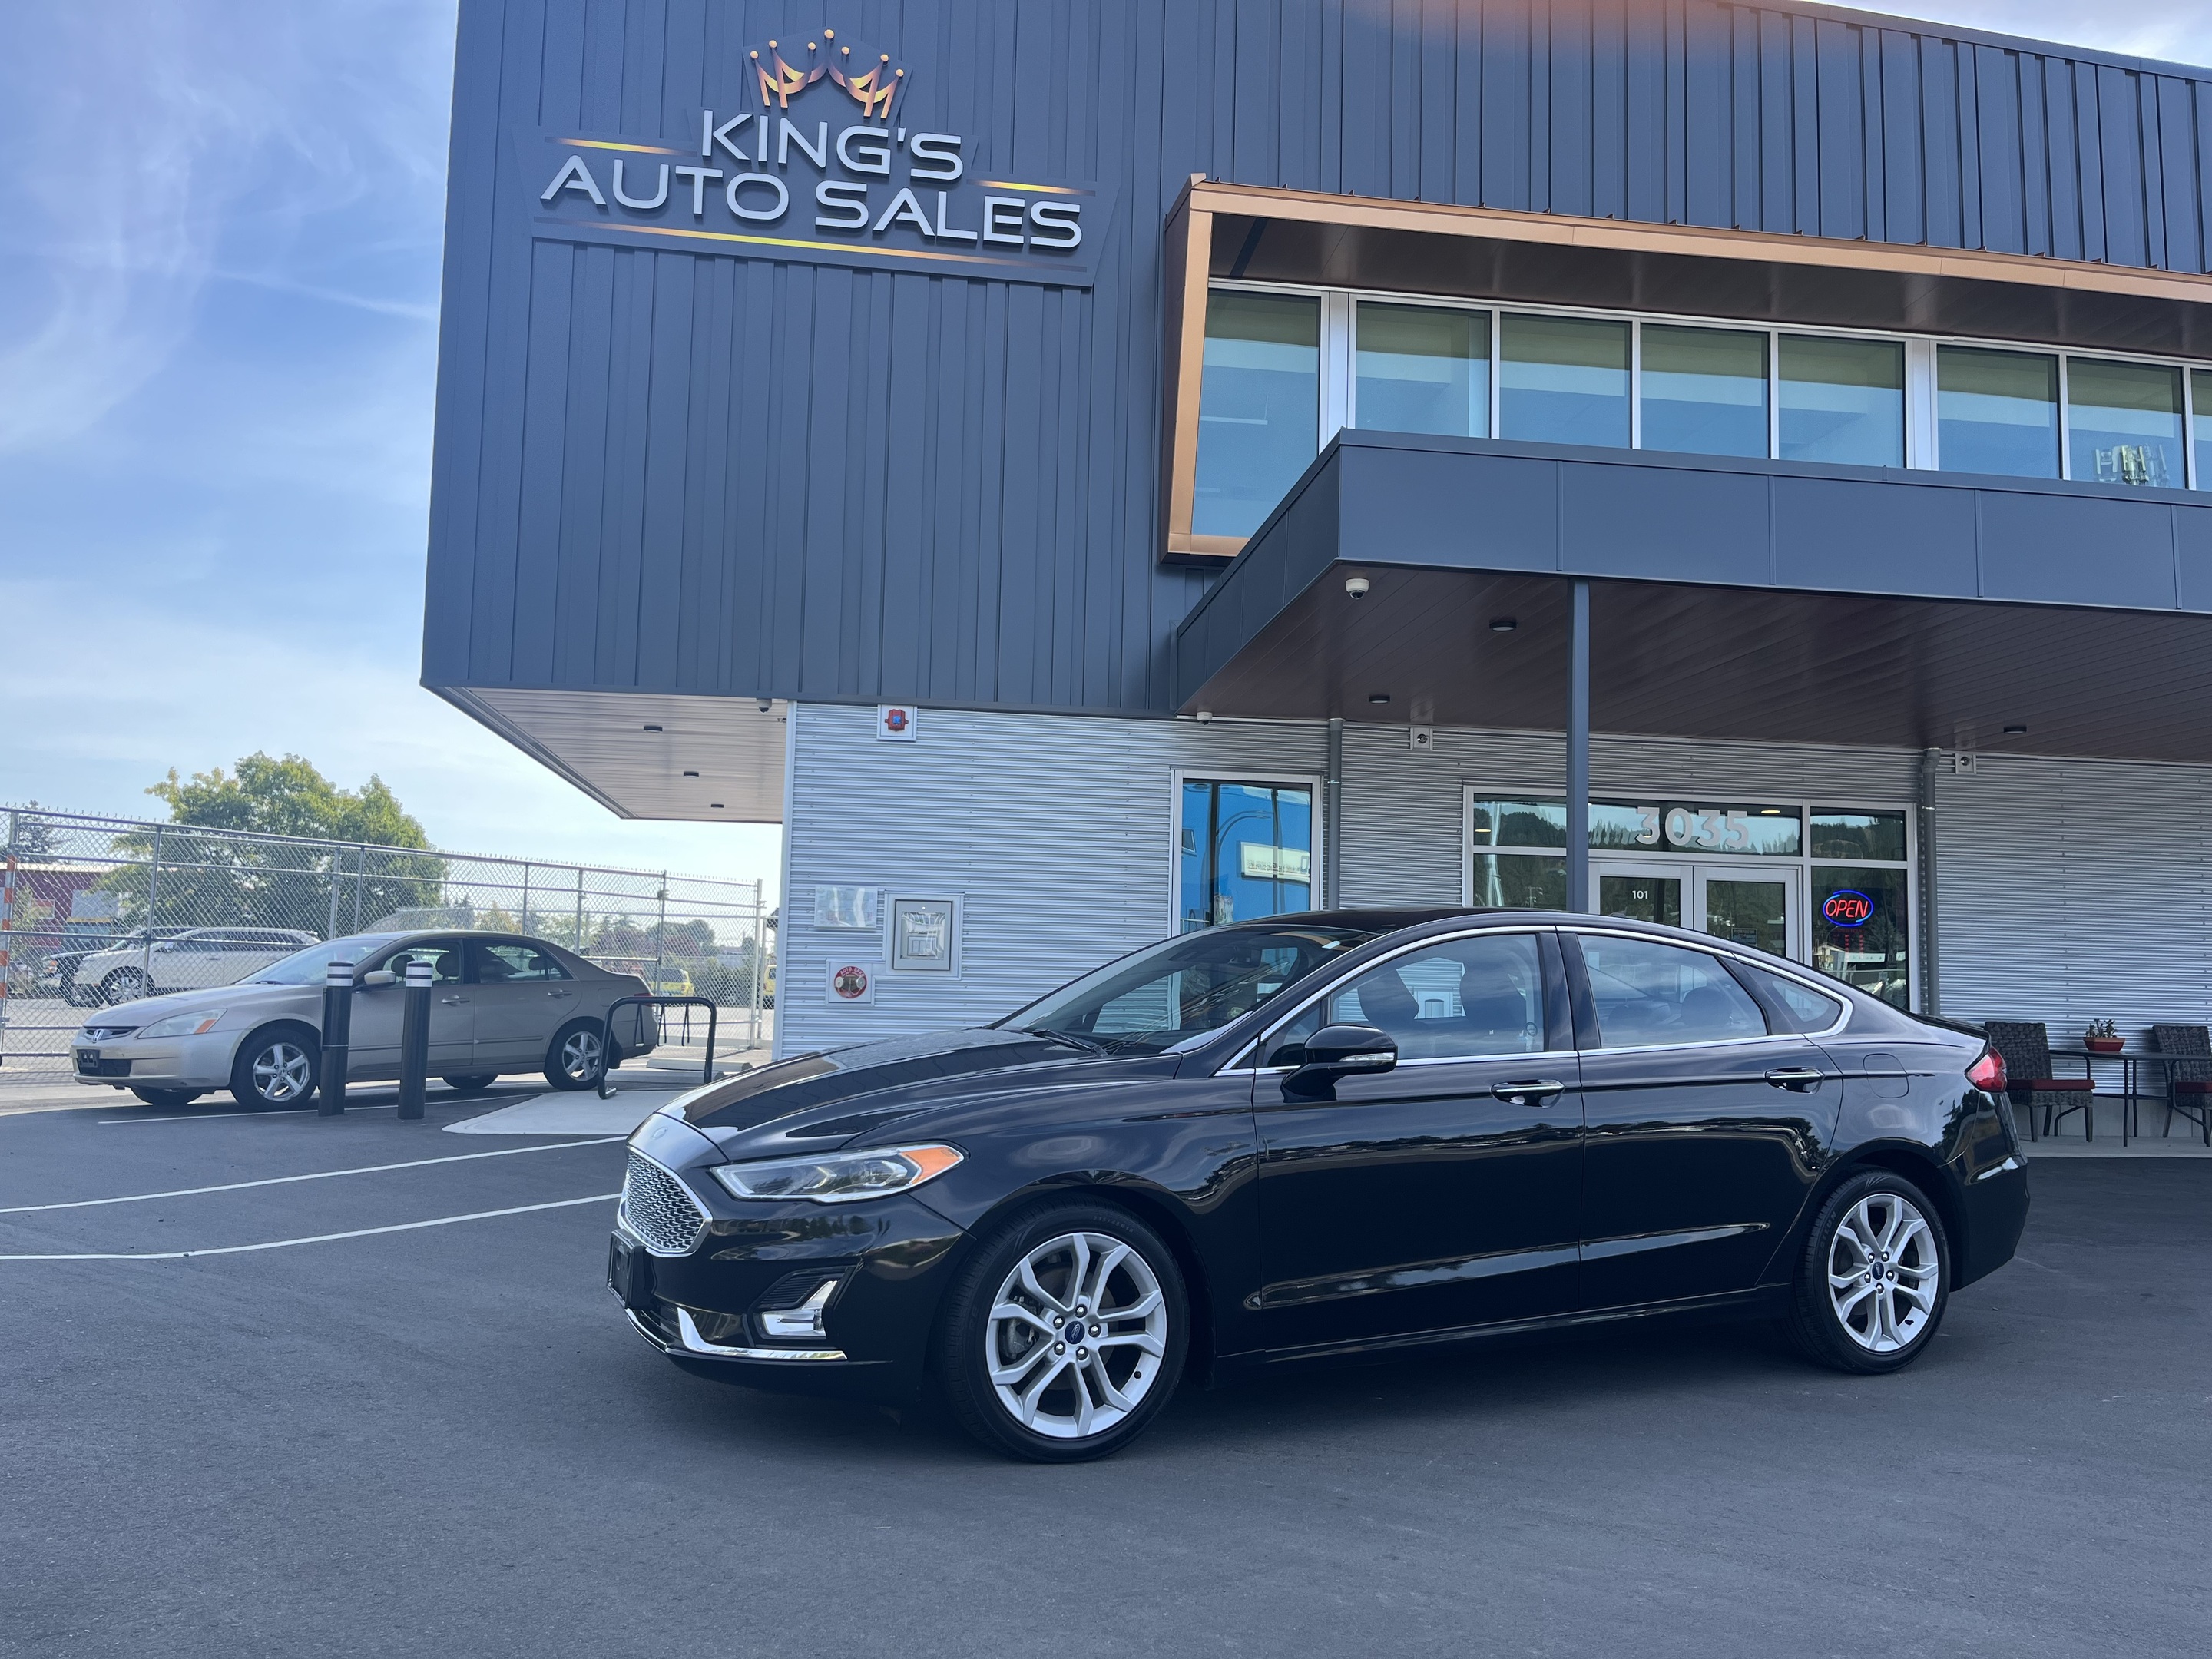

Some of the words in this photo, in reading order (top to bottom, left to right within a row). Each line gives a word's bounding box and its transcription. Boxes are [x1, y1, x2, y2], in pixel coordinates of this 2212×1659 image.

[701, 109, 963, 181] KING'S
[540, 154, 790, 221] AUTO
[814, 182, 1083, 249] SALES
[1635, 806, 1749, 849] 3035
[1632, 890, 1648, 899] 101
[1826, 899, 1868, 917] OPEN
